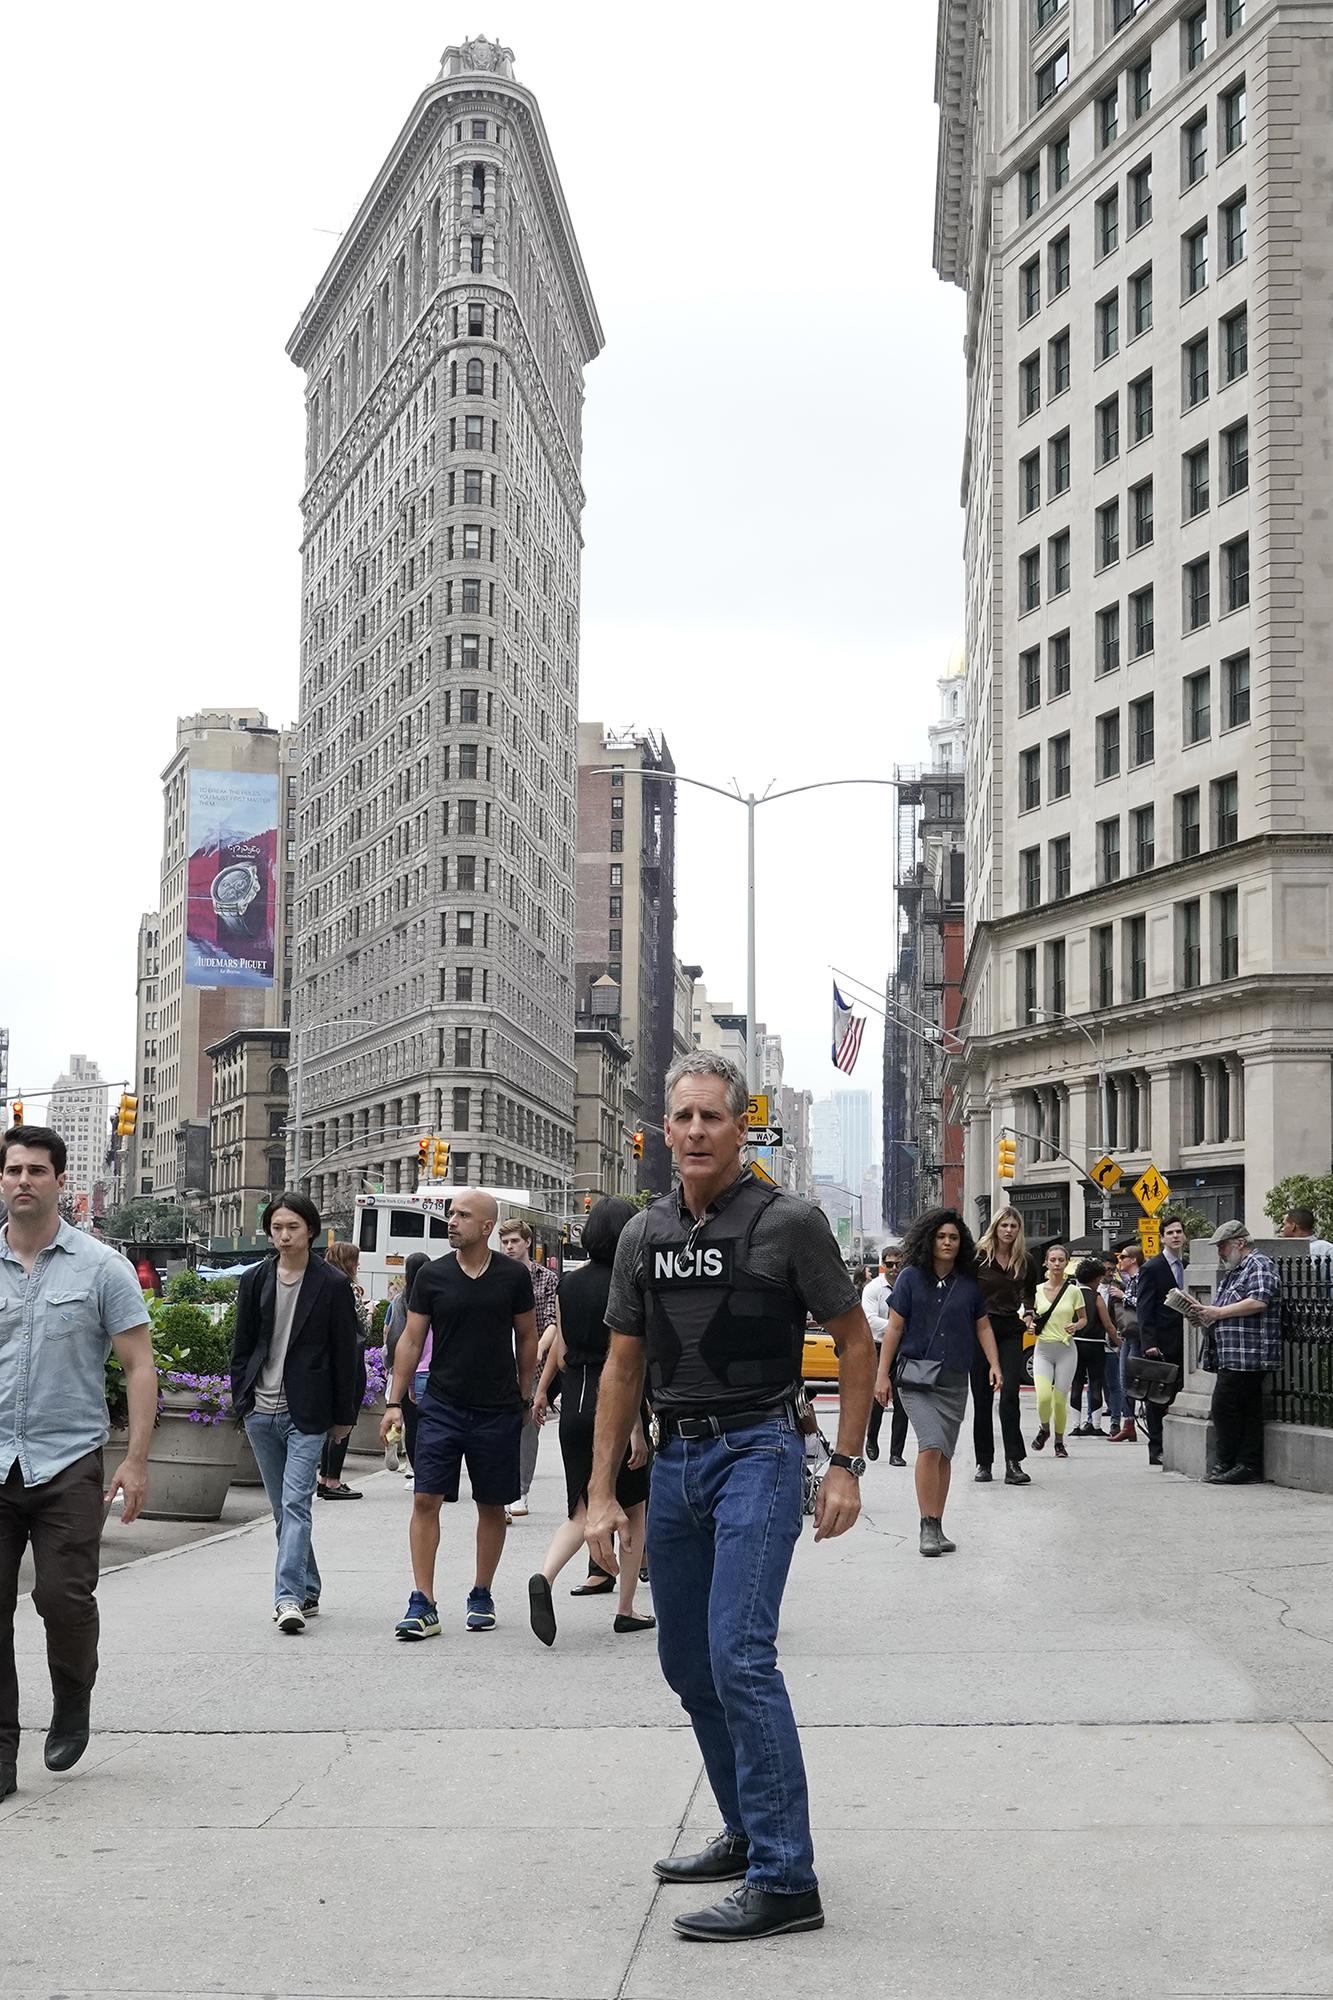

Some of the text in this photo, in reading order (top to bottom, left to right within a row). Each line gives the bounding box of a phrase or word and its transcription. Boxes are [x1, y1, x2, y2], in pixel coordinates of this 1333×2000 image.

[194, 956, 267, 969] AUDEMARS PIGUET
[748, 1100, 759, 1114] 5
[756, 1133, 775, 1141] WAY
[422, 1201, 444, 1211] 6719
[1147, 1236, 1154, 1248] 5
[655, 1248, 723, 1279] NCIS
